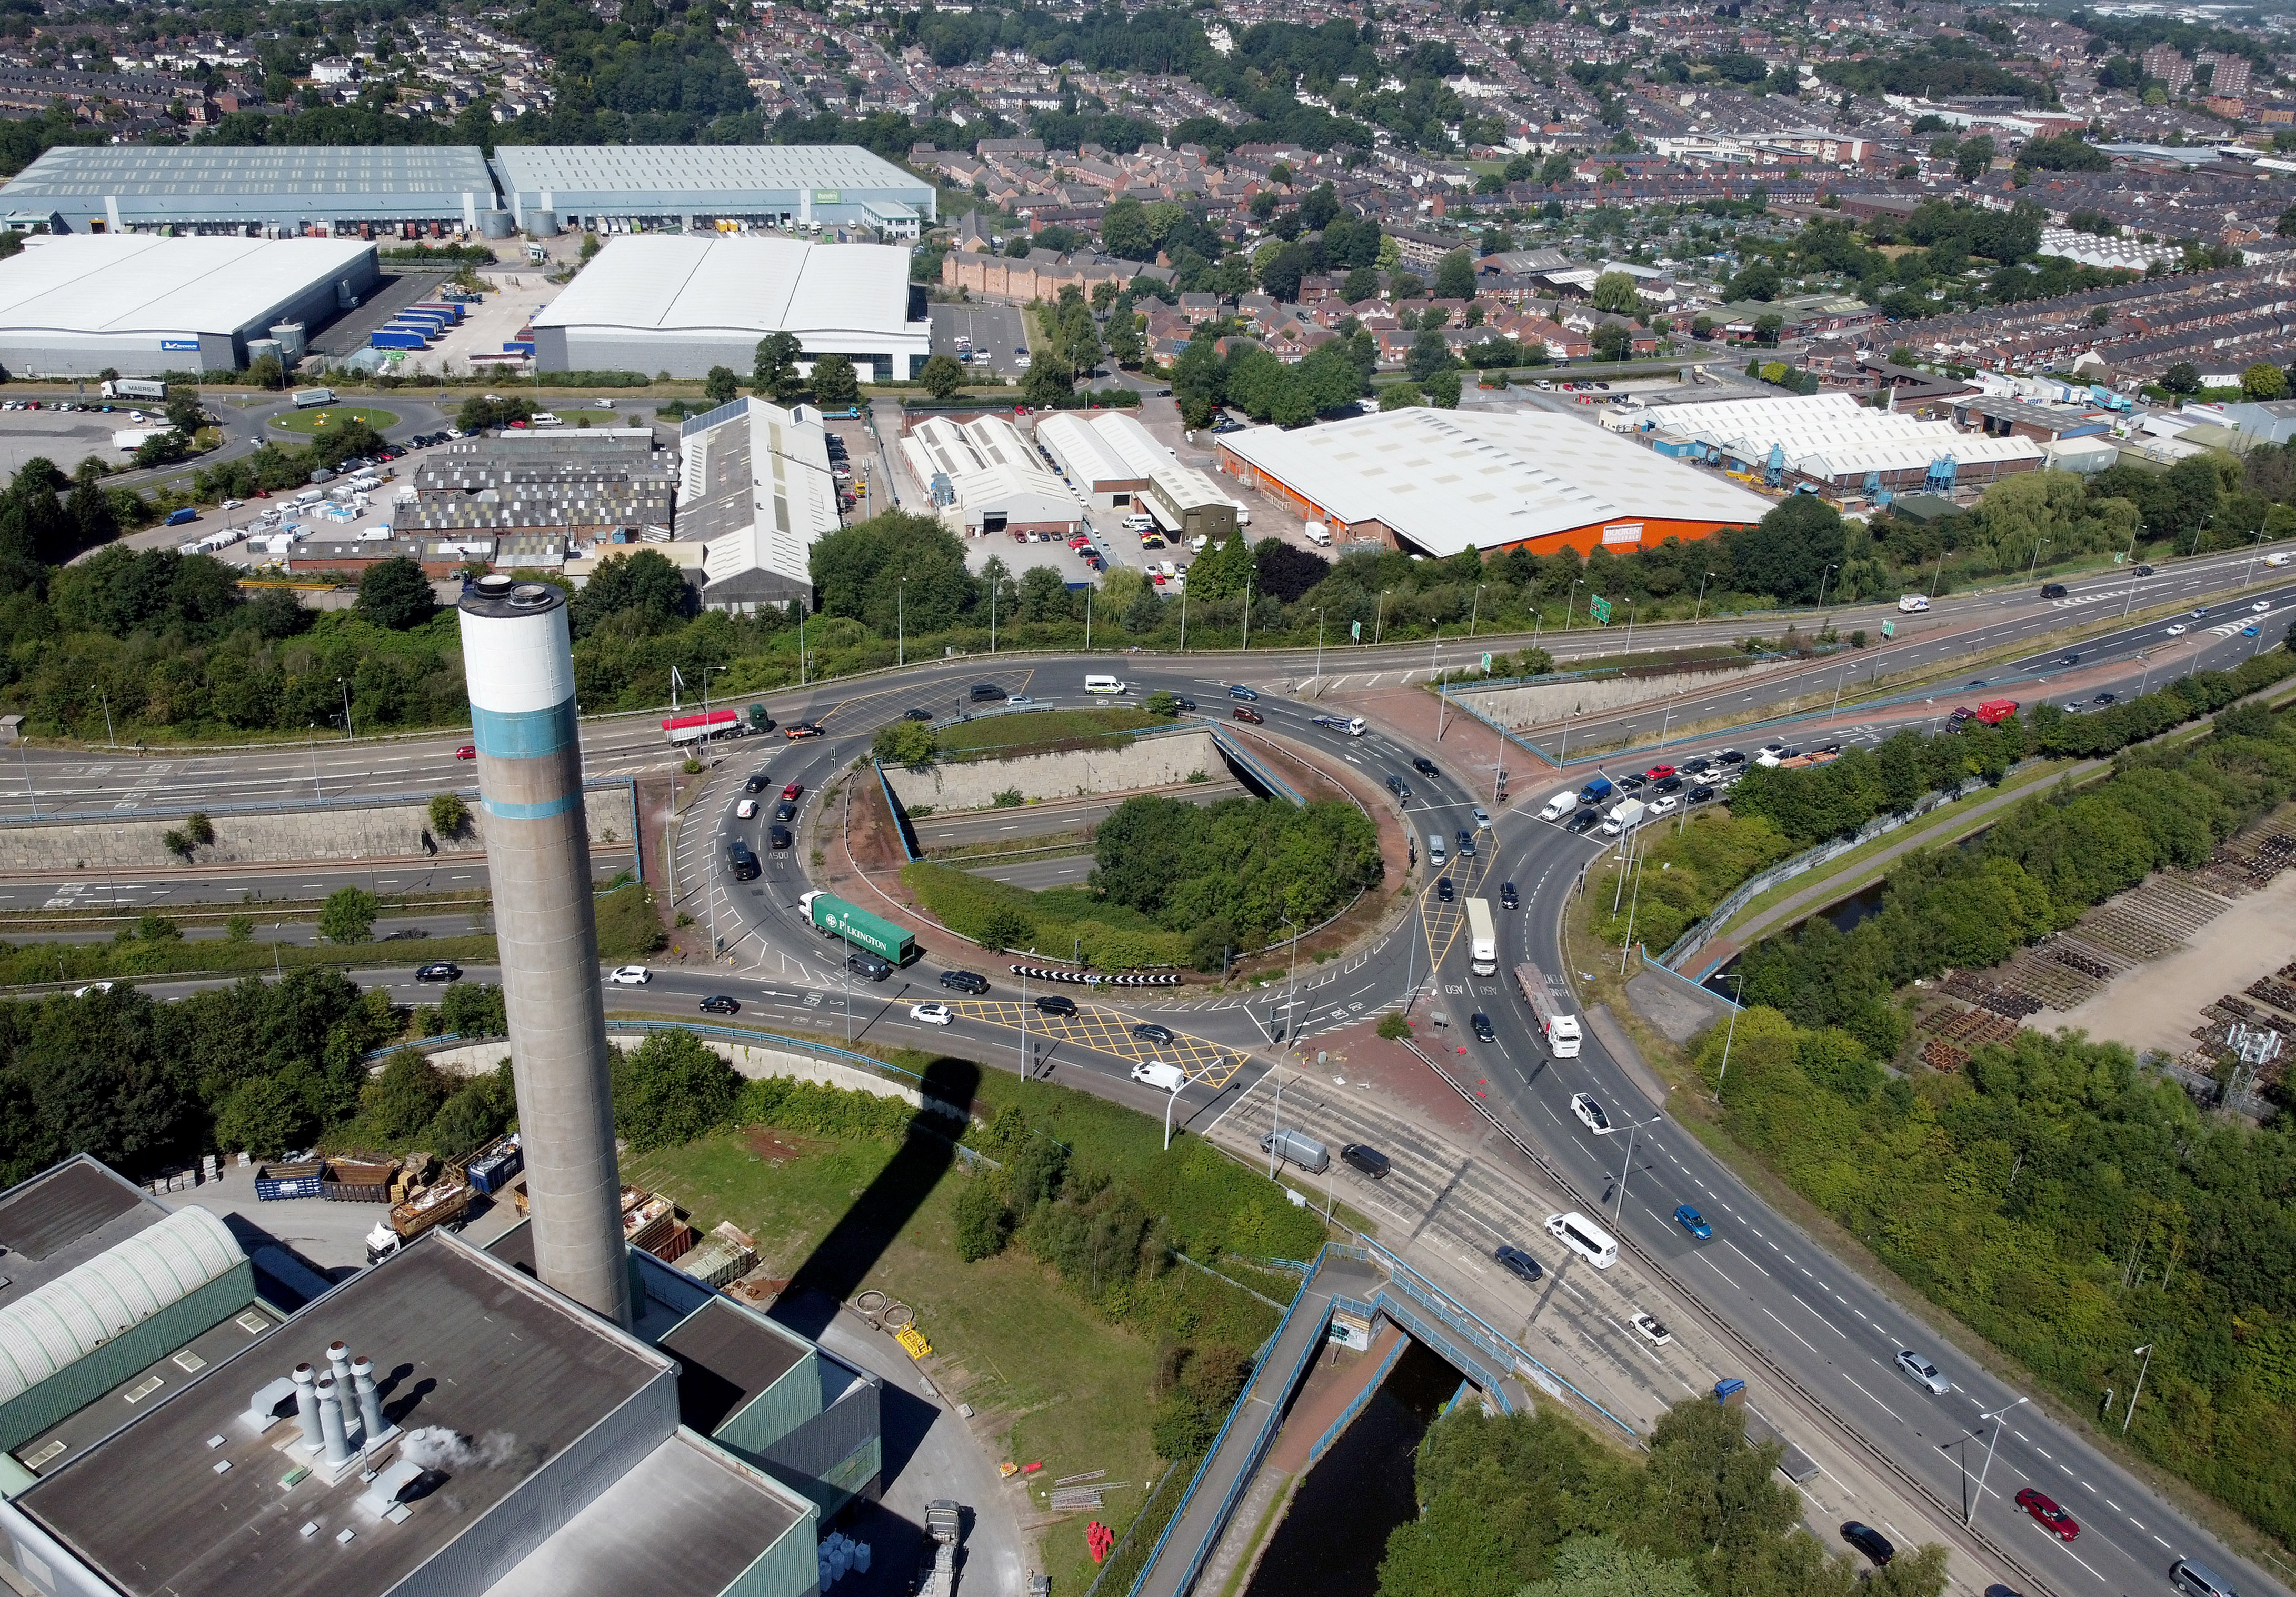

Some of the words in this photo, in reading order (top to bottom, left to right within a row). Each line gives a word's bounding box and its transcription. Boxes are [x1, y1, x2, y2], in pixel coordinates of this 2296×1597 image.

[1976, 373, 1990, 383] FedEx
[1605, 527, 1640, 537] BOOKER
[838, 920, 887, 952] PLKINGTON
[1445, 985, 1463, 994] A50
[1480, 986, 1497, 995] A50
